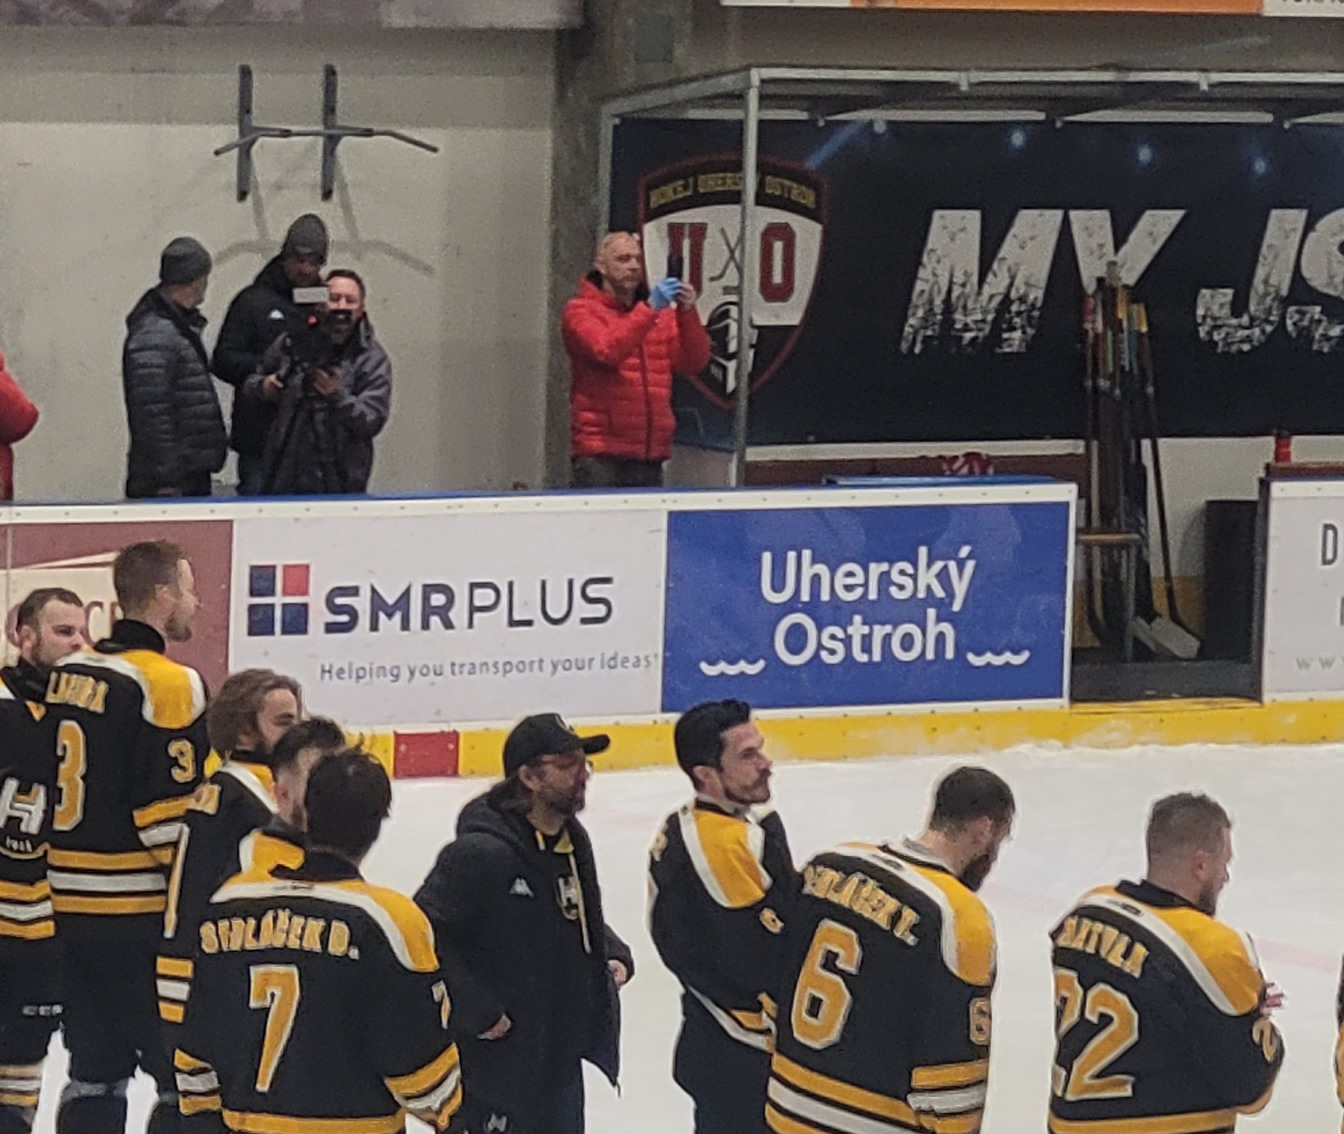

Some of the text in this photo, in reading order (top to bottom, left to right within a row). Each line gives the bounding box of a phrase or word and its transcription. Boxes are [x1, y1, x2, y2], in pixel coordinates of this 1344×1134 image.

[899, 208, 1188, 354] MY
[760, 545, 976, 612] Uherský
[320, 662, 401, 683] Helping
[407, 662, 445, 681] you
[450, 658, 546, 678] transport
[550, 656, 595, 676] your
[774, 609, 955, 667] Ostroh
[167, 738, 197, 783] 3
[790, 917, 863, 1051] 6
[249, 964, 302, 1093] 7
